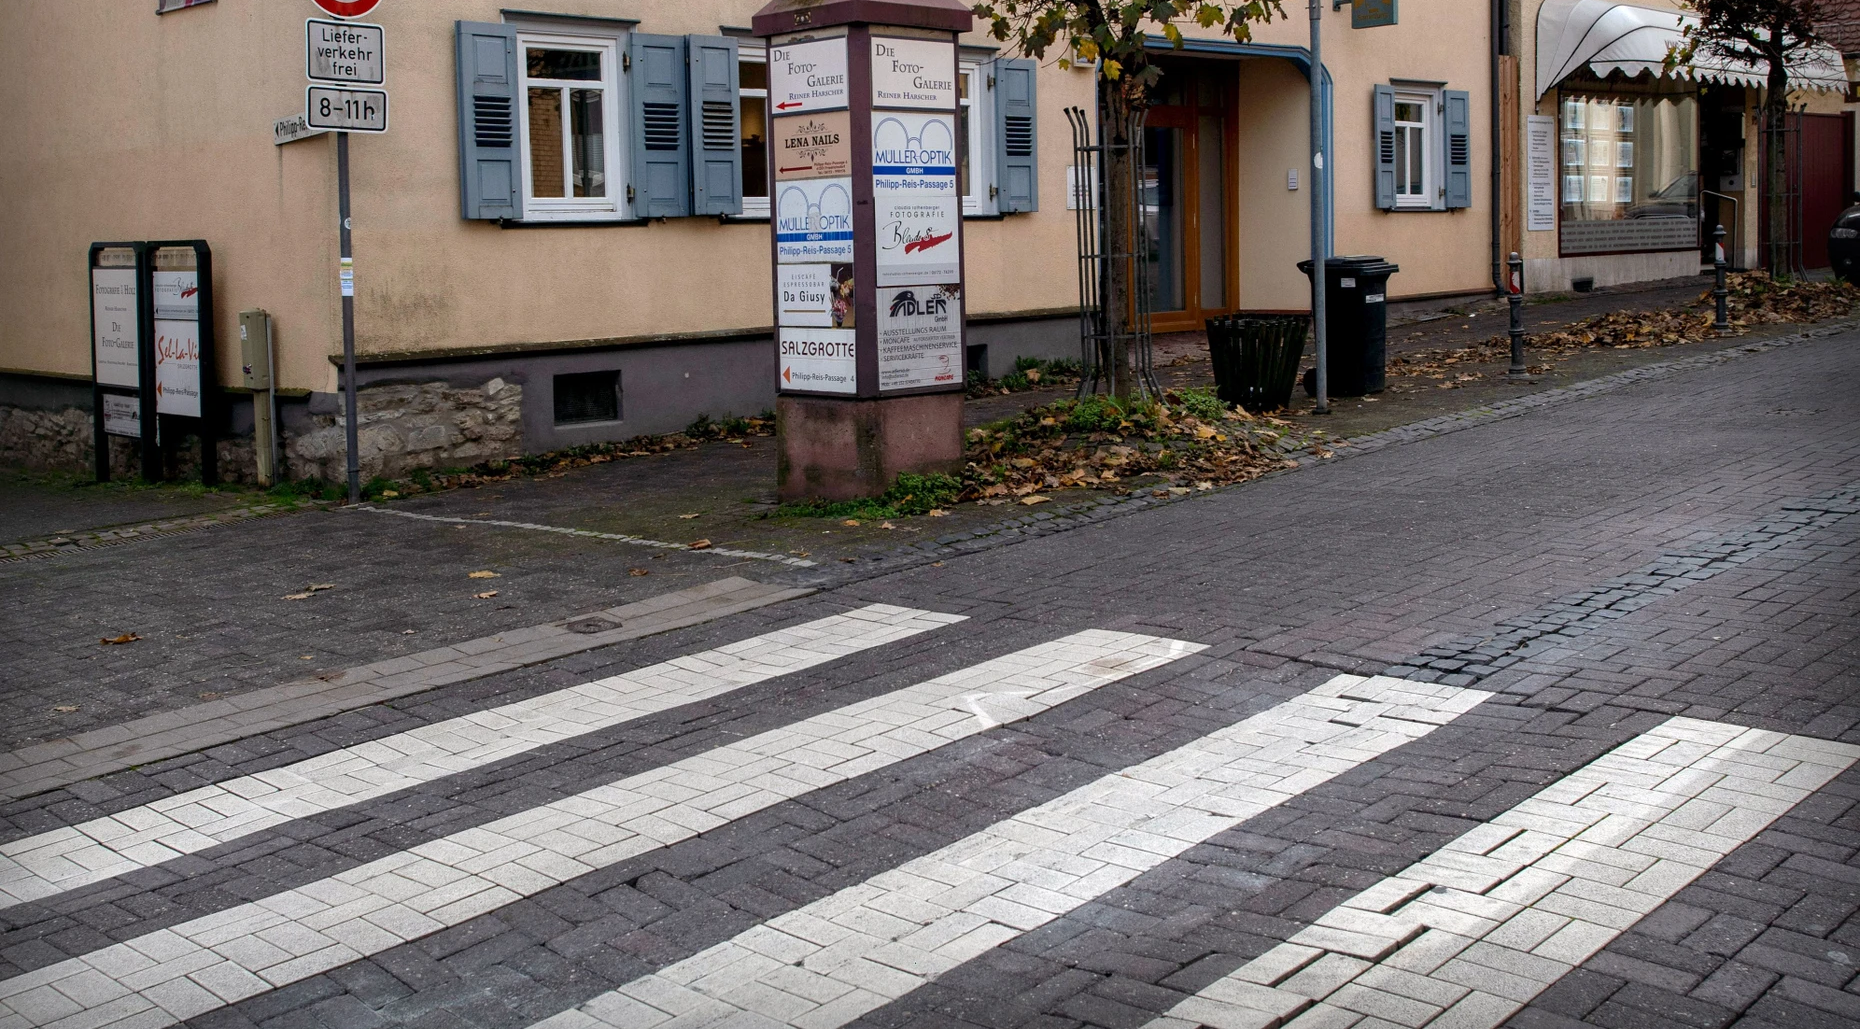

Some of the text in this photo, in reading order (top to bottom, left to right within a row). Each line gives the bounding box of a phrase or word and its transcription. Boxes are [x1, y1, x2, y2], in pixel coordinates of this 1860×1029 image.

[322, 28, 367, 44] Liefer-
[317, 46, 372, 61] verkehr
[333, 62, 357, 76] frei
[807, 74, 844, 87] GALERIE
[913, 76, 952, 90] GALERIE
[785, 134, 840, 149] LENA NAILS
[875, 179, 954, 190] Philipp-Reis-Passage 5
[780, 245, 852, 256] Philipp-Reis-Passage 5
[784, 290, 825, 304] Da Giusy
[889, 297, 947, 317] ADLER
[782, 340, 854, 357] SALZGROTTE
[882, 341, 958, 353] KAFFEEMASCHINENSERVICE
[792, 372, 847, 383] Philipp-Reis-Passage
